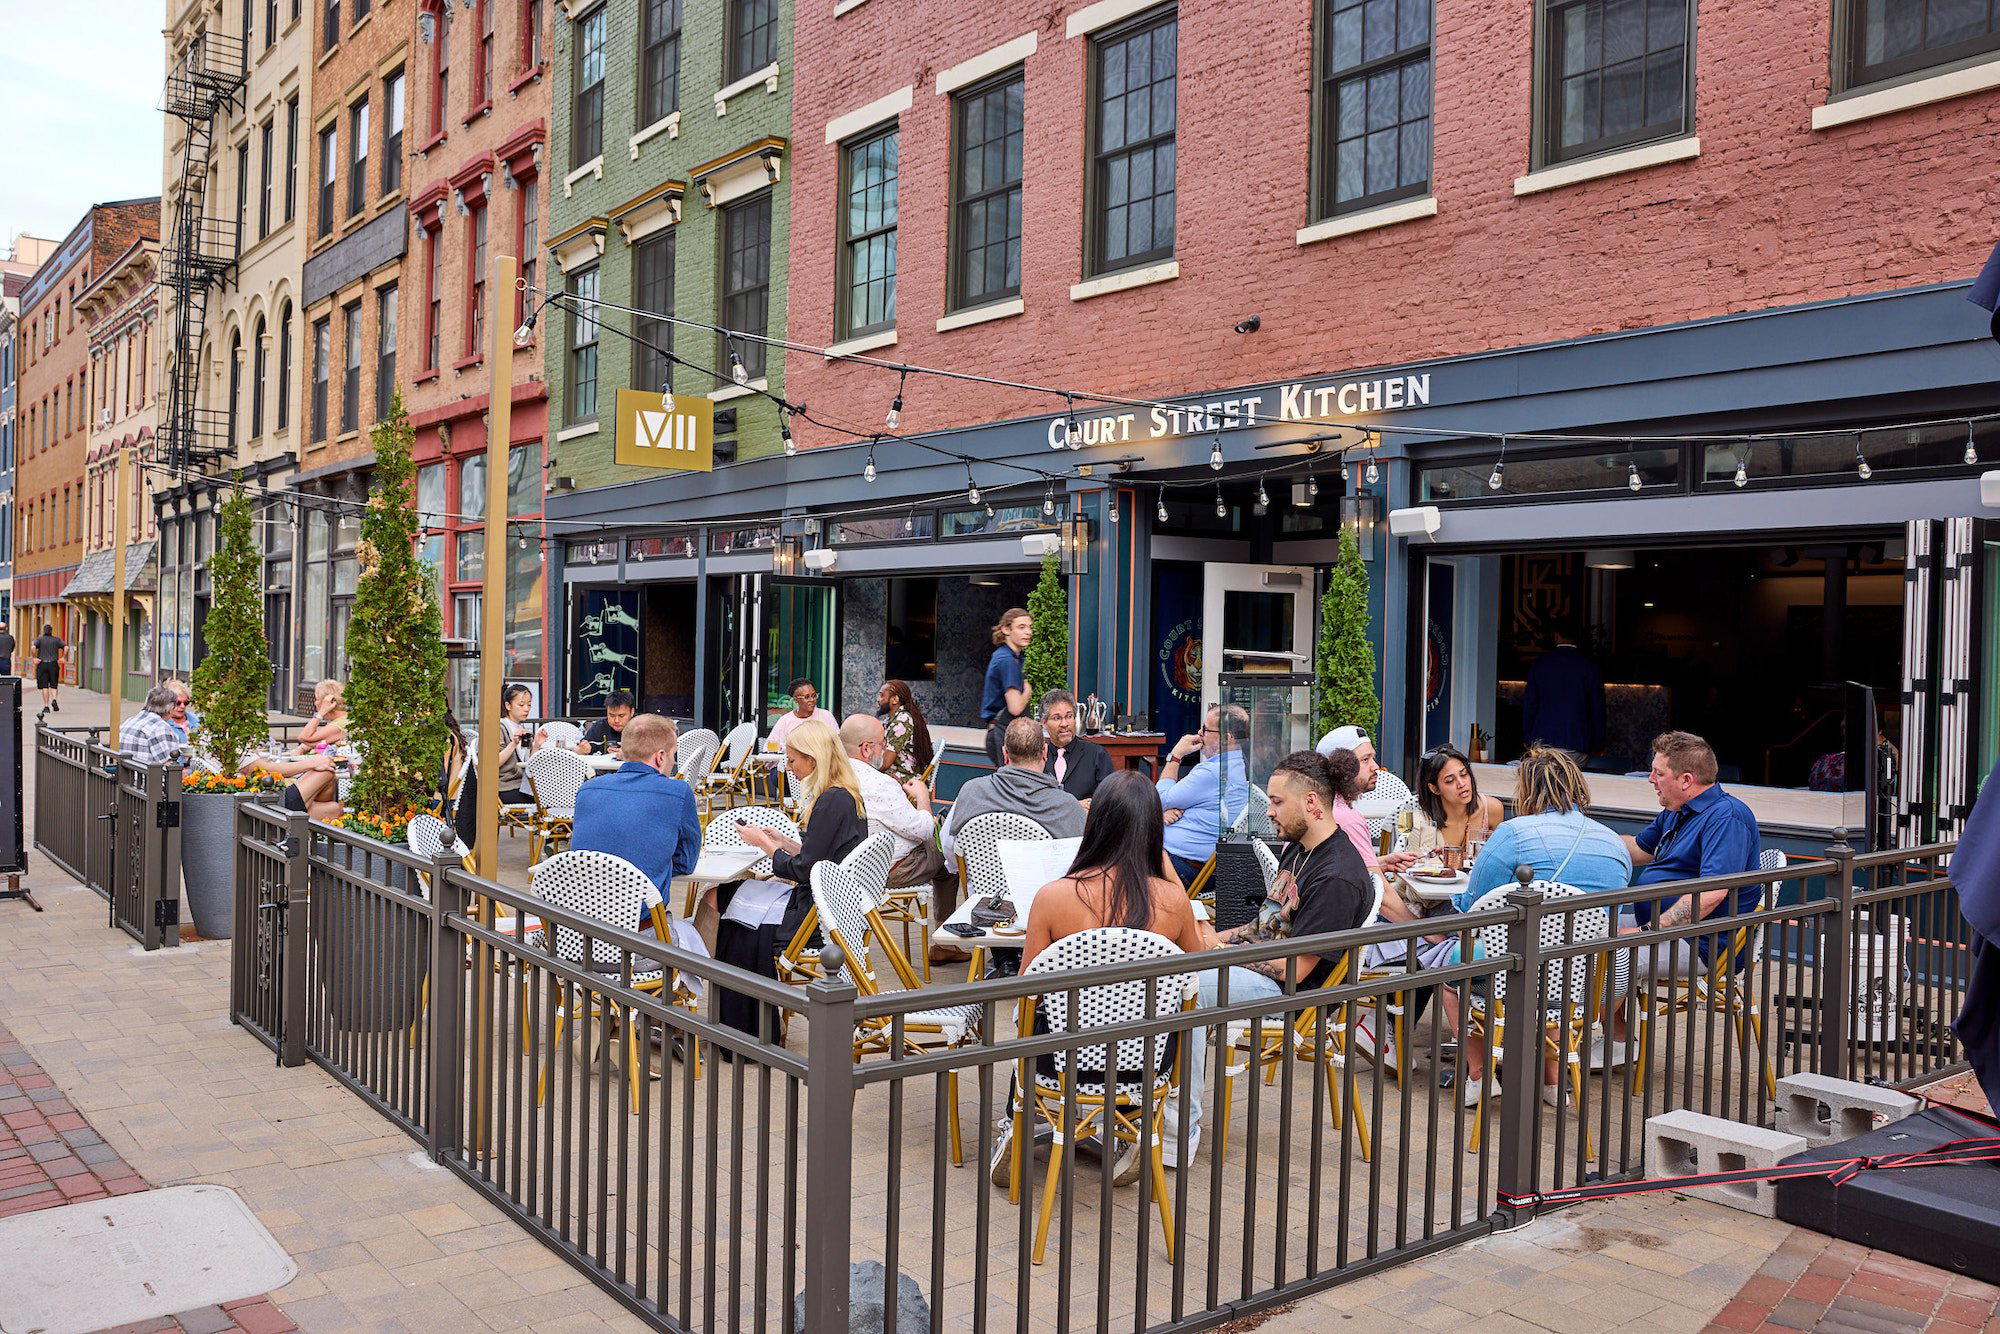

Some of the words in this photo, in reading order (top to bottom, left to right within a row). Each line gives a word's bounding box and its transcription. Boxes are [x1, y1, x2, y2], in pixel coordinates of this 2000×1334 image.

[1047, 413, 1135, 450] COURT
[1149, 396, 1262, 438] STREET
[1279, 373, 1431, 421] KITCHEN
[1159, 618, 1193, 661] COURT
